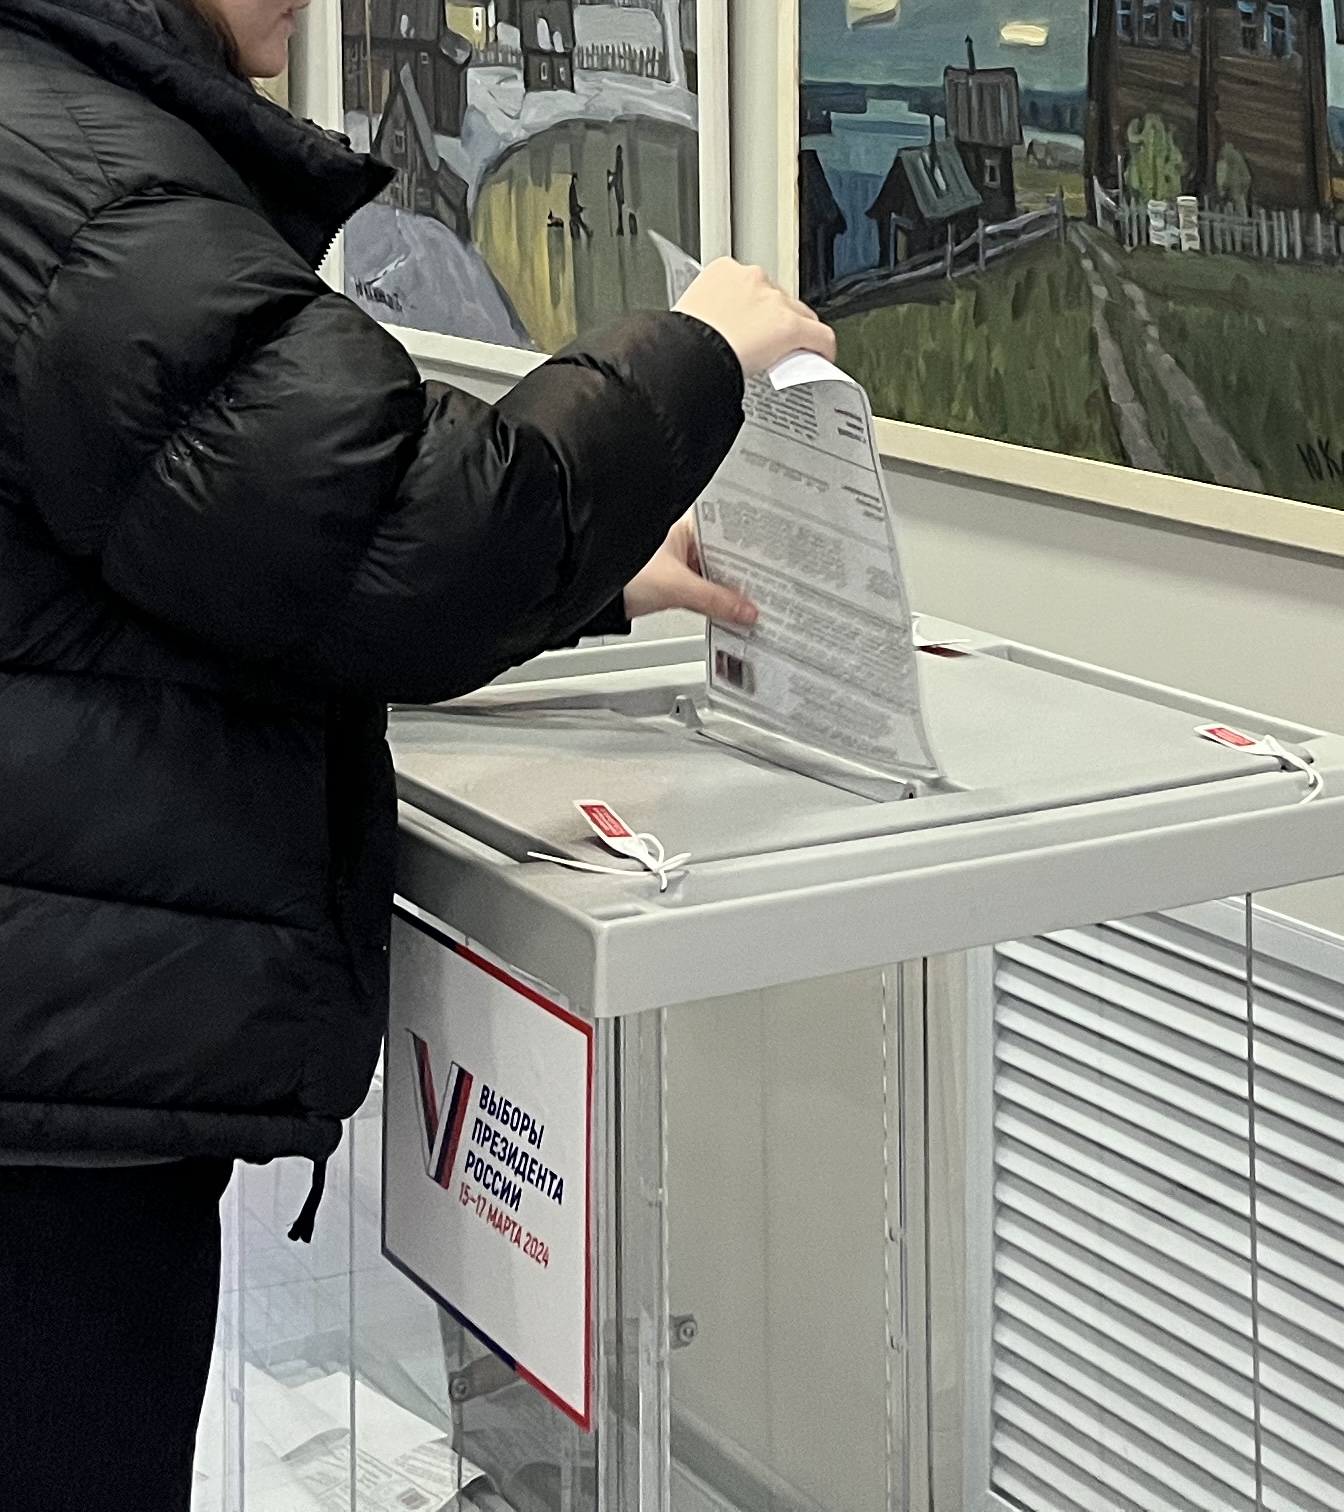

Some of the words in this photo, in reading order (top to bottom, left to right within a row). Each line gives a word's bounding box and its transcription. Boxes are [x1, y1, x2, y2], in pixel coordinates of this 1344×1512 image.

[478, 1084, 545, 1149] ВЫБОРЫ
[464, 1149, 522, 1212] РОССИИ
[471, 1117, 565, 1206] ПРЕЗИДЕНТА
[487, 1203, 523, 1248] МАРТА
[523, 1232, 550, 1269] 2024
